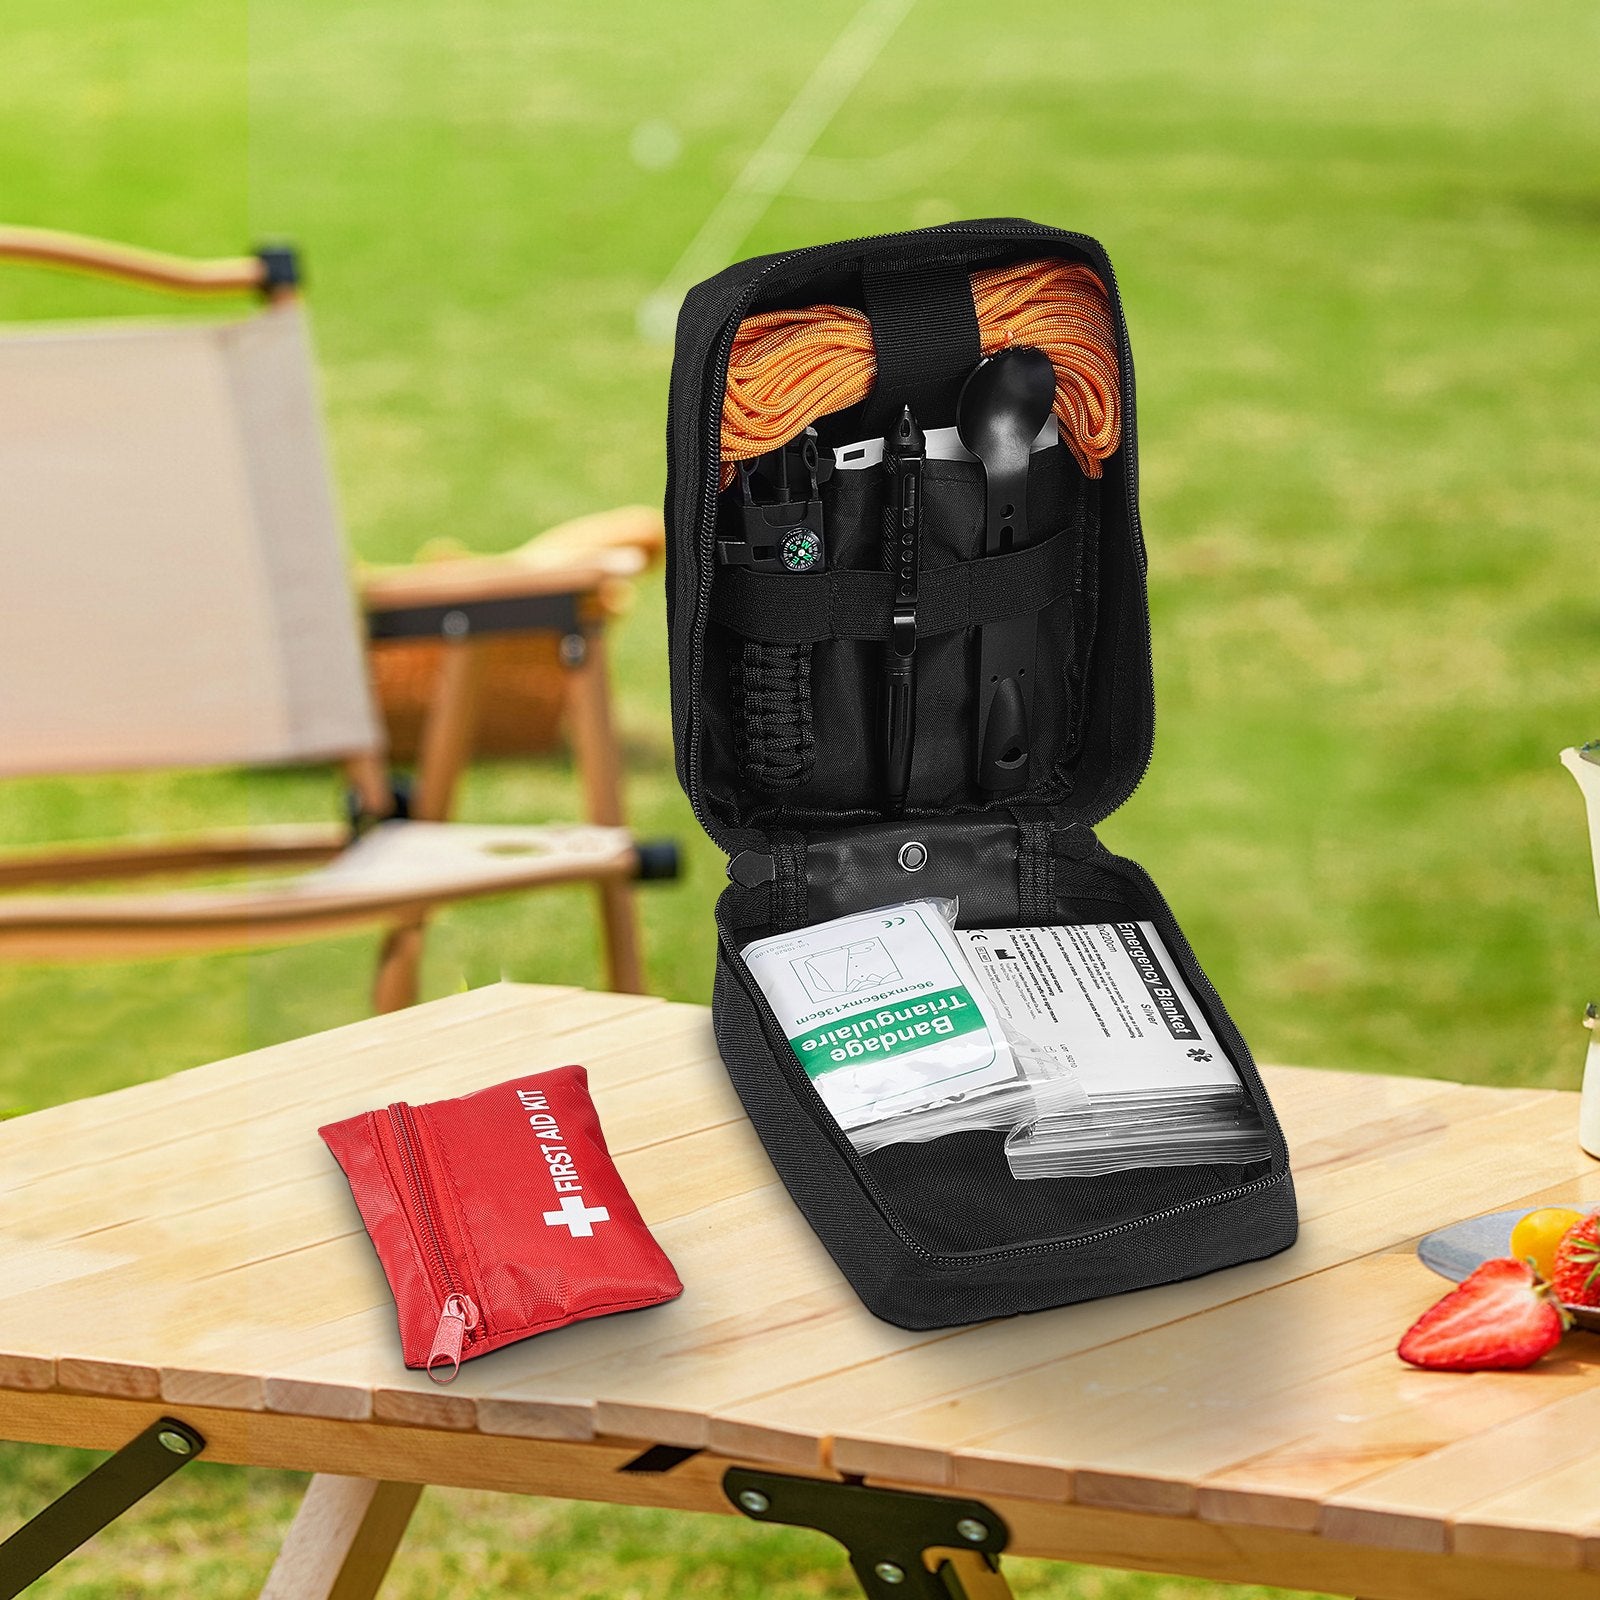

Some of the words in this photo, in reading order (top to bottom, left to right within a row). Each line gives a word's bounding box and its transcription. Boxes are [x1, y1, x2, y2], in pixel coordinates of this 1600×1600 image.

[1116, 923, 1164, 985] Emergency
[1153, 986, 1190, 1035] Blanket
[796, 981, 934, 1026] 96cmx96cmx136cm
[801, 995, 967, 1052] Triangulaire
[1141, 1003, 1158, 1025] Silver
[831, 1016, 954, 1062] Bandage
[516, 1089, 550, 1111] KIT
[529, 1114, 564, 1140] AID
[540, 1144, 582, 1192] FIRST
